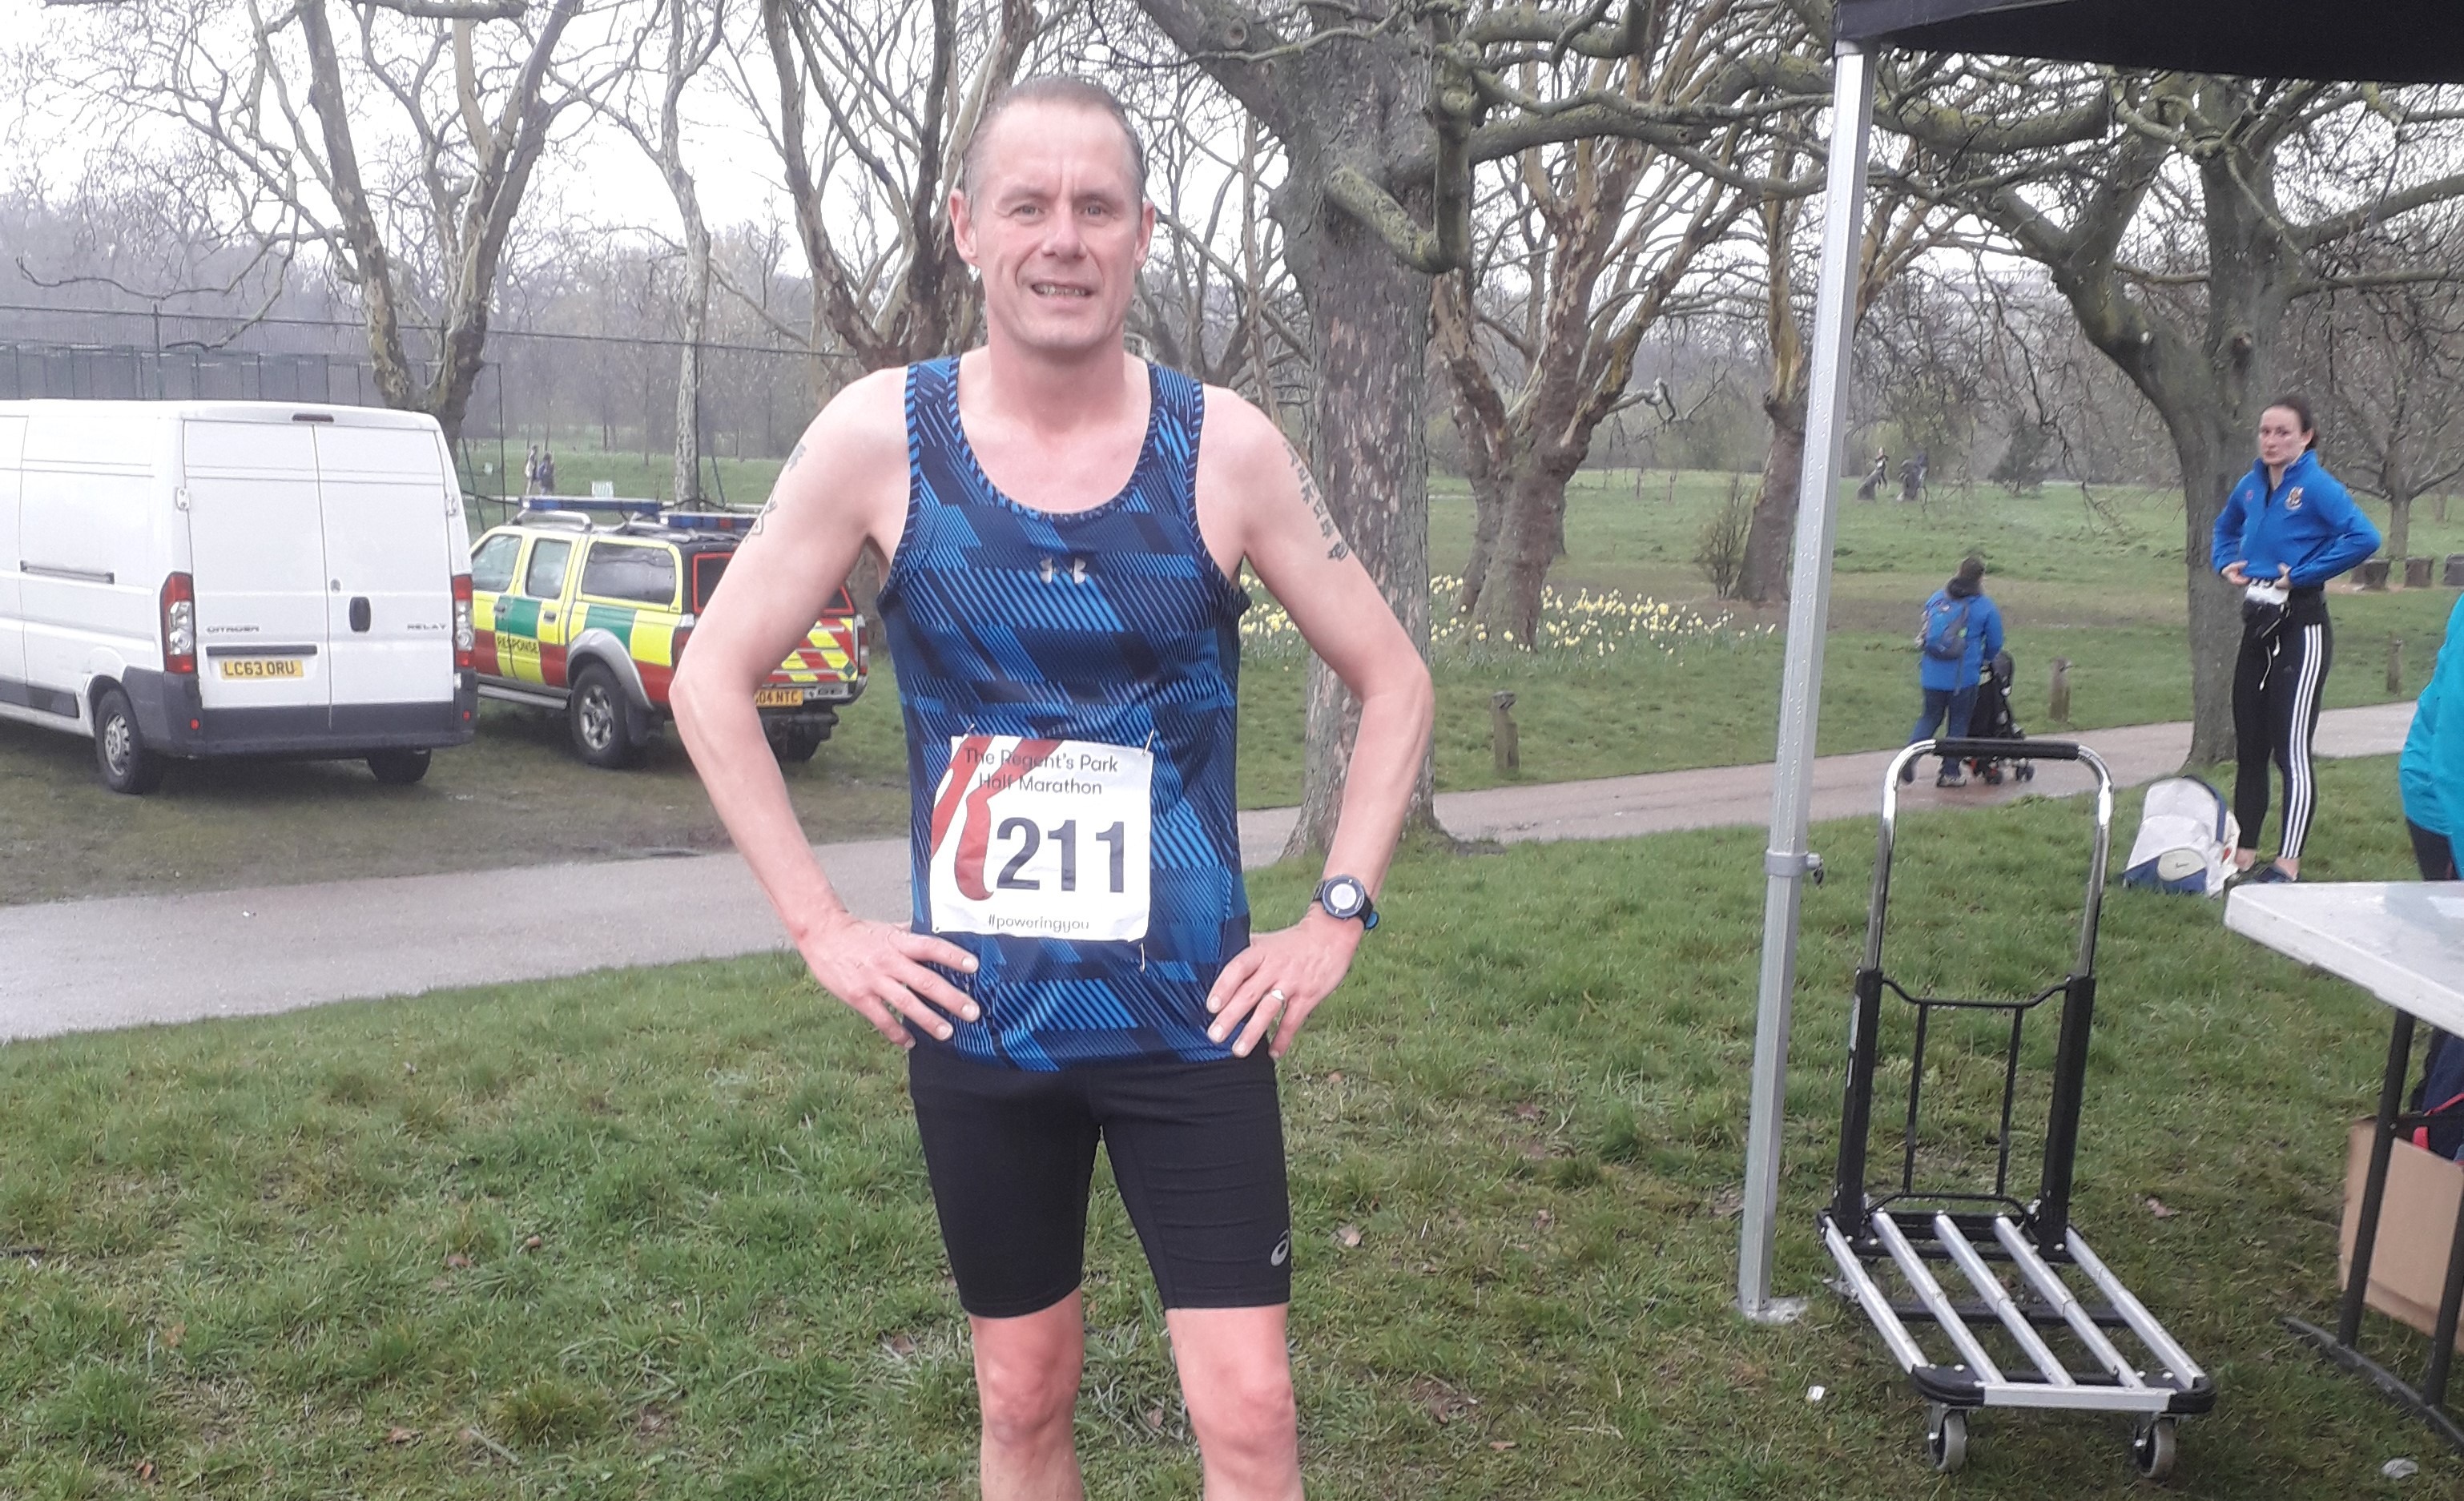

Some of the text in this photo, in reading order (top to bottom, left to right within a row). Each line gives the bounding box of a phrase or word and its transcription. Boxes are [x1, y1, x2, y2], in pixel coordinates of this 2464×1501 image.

[497, 636, 539, 654] RESPONSE
[223, 660, 296, 676] LC63 ORU
[775, 690, 799, 703] NTC
[965, 747, 1119, 773] The Regent's Park
[979, 771, 1103, 795] Half Marathon
[996, 816, 1125, 894] 211
[988, 913, 1090, 934] #poweringyou
